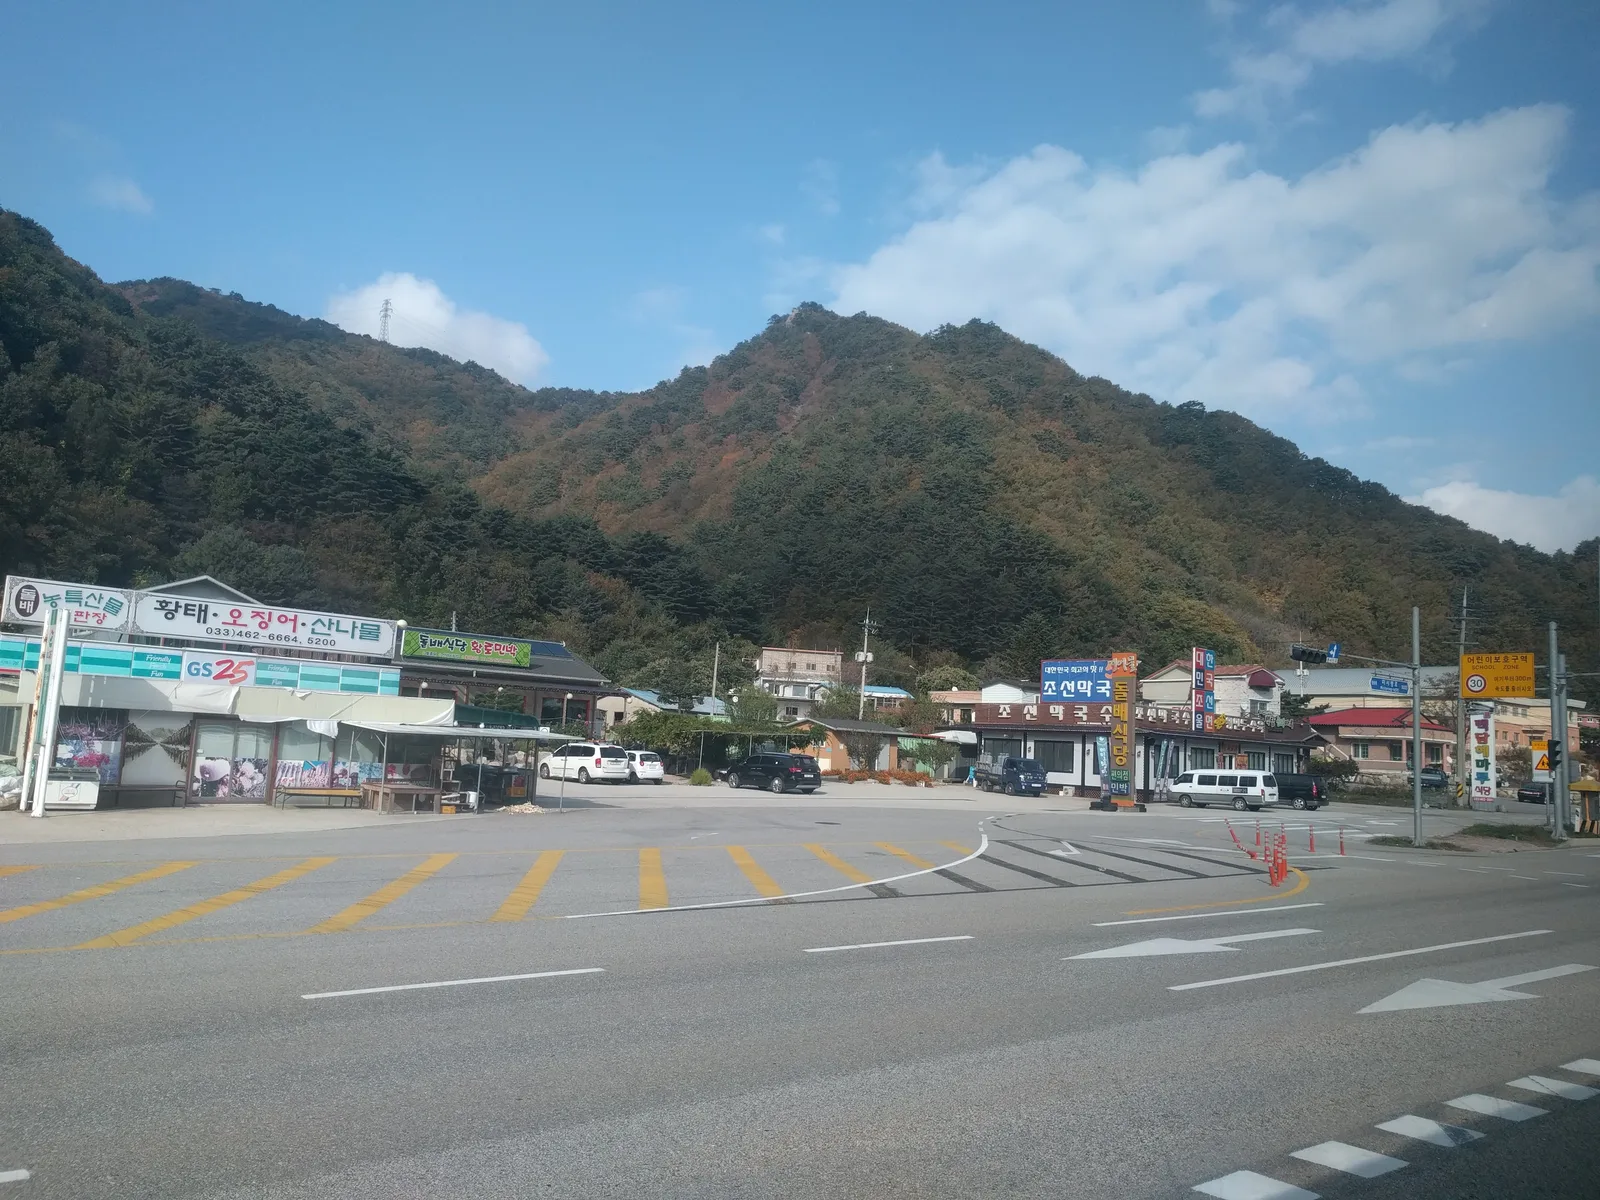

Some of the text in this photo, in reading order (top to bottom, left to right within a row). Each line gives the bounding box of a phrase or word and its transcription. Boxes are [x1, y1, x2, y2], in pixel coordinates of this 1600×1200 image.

[42, 589, 124, 617] 농특산물
[307, 637, 337, 647] 5200
[419, 632, 467, 652] 돌배식당
[145, 654, 172, 664] Friendly
[1467, 655, 1528, 664] 어린이보호구역
[187, 659, 255, 685] GS25
[267, 664, 290, 673] Friendly
[1044, 666, 1069, 674] 대한민국
[1042, 680, 1111, 698] 조선막국
[1470, 679, 1483, 688] 30
[998, 704, 1112, 722] 조선막국수
[1135, 705, 1191, 725] 조선막국수
[1111, 681, 1130, 766] 돌배식당
[1110, 770, 1129, 781] 편의점
[1110, 782, 1129, 795] 민박
[1475, 786, 1491, 796] 식당
